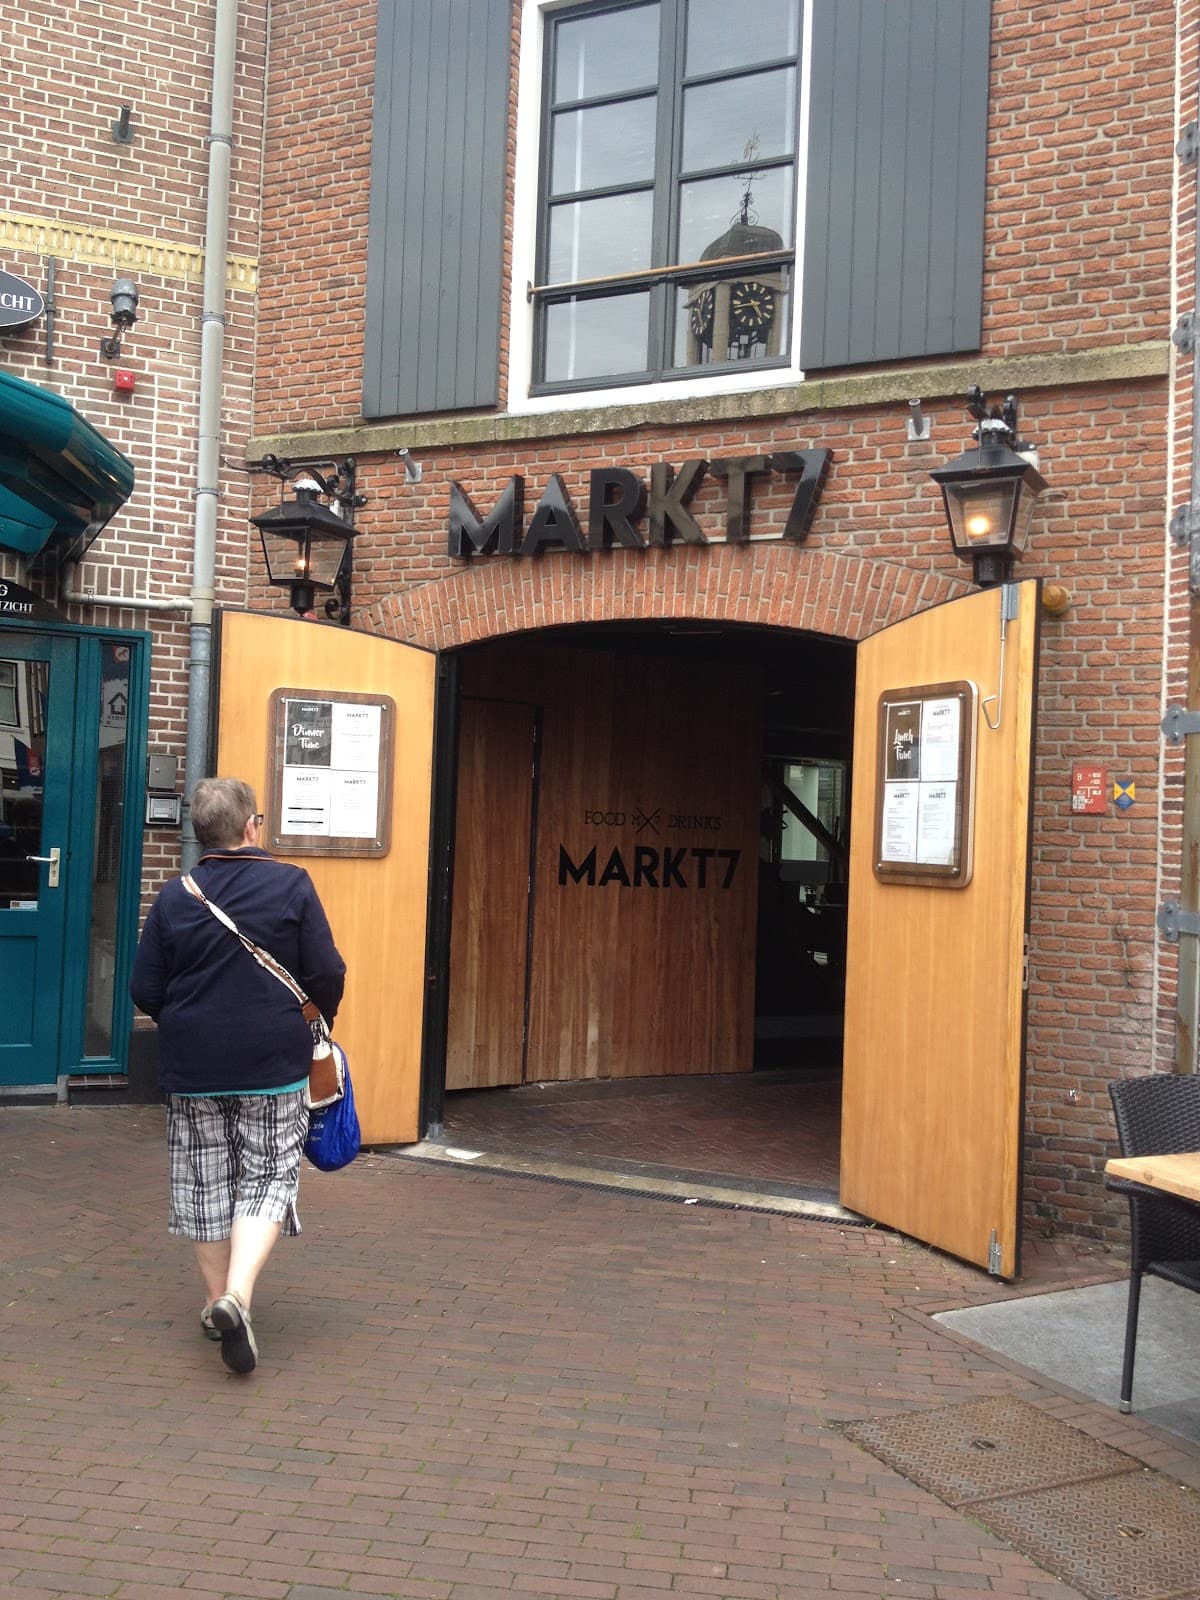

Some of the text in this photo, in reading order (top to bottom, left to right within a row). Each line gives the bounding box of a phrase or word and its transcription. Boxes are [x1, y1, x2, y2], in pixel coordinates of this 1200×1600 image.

[0, 293, 35, 310] CHT
[448, 448, 833, 557] MARKT7
[291, 724, 325, 737] Dinner
[893, 729, 914, 745] Lunch
[298, 737, 320, 749] Time
[893, 745, 912, 761] Time
[584, 811, 626, 826] FOOD
[667, 815, 722, 831] DRINKS
[558, 843, 742, 889] MARKT7
